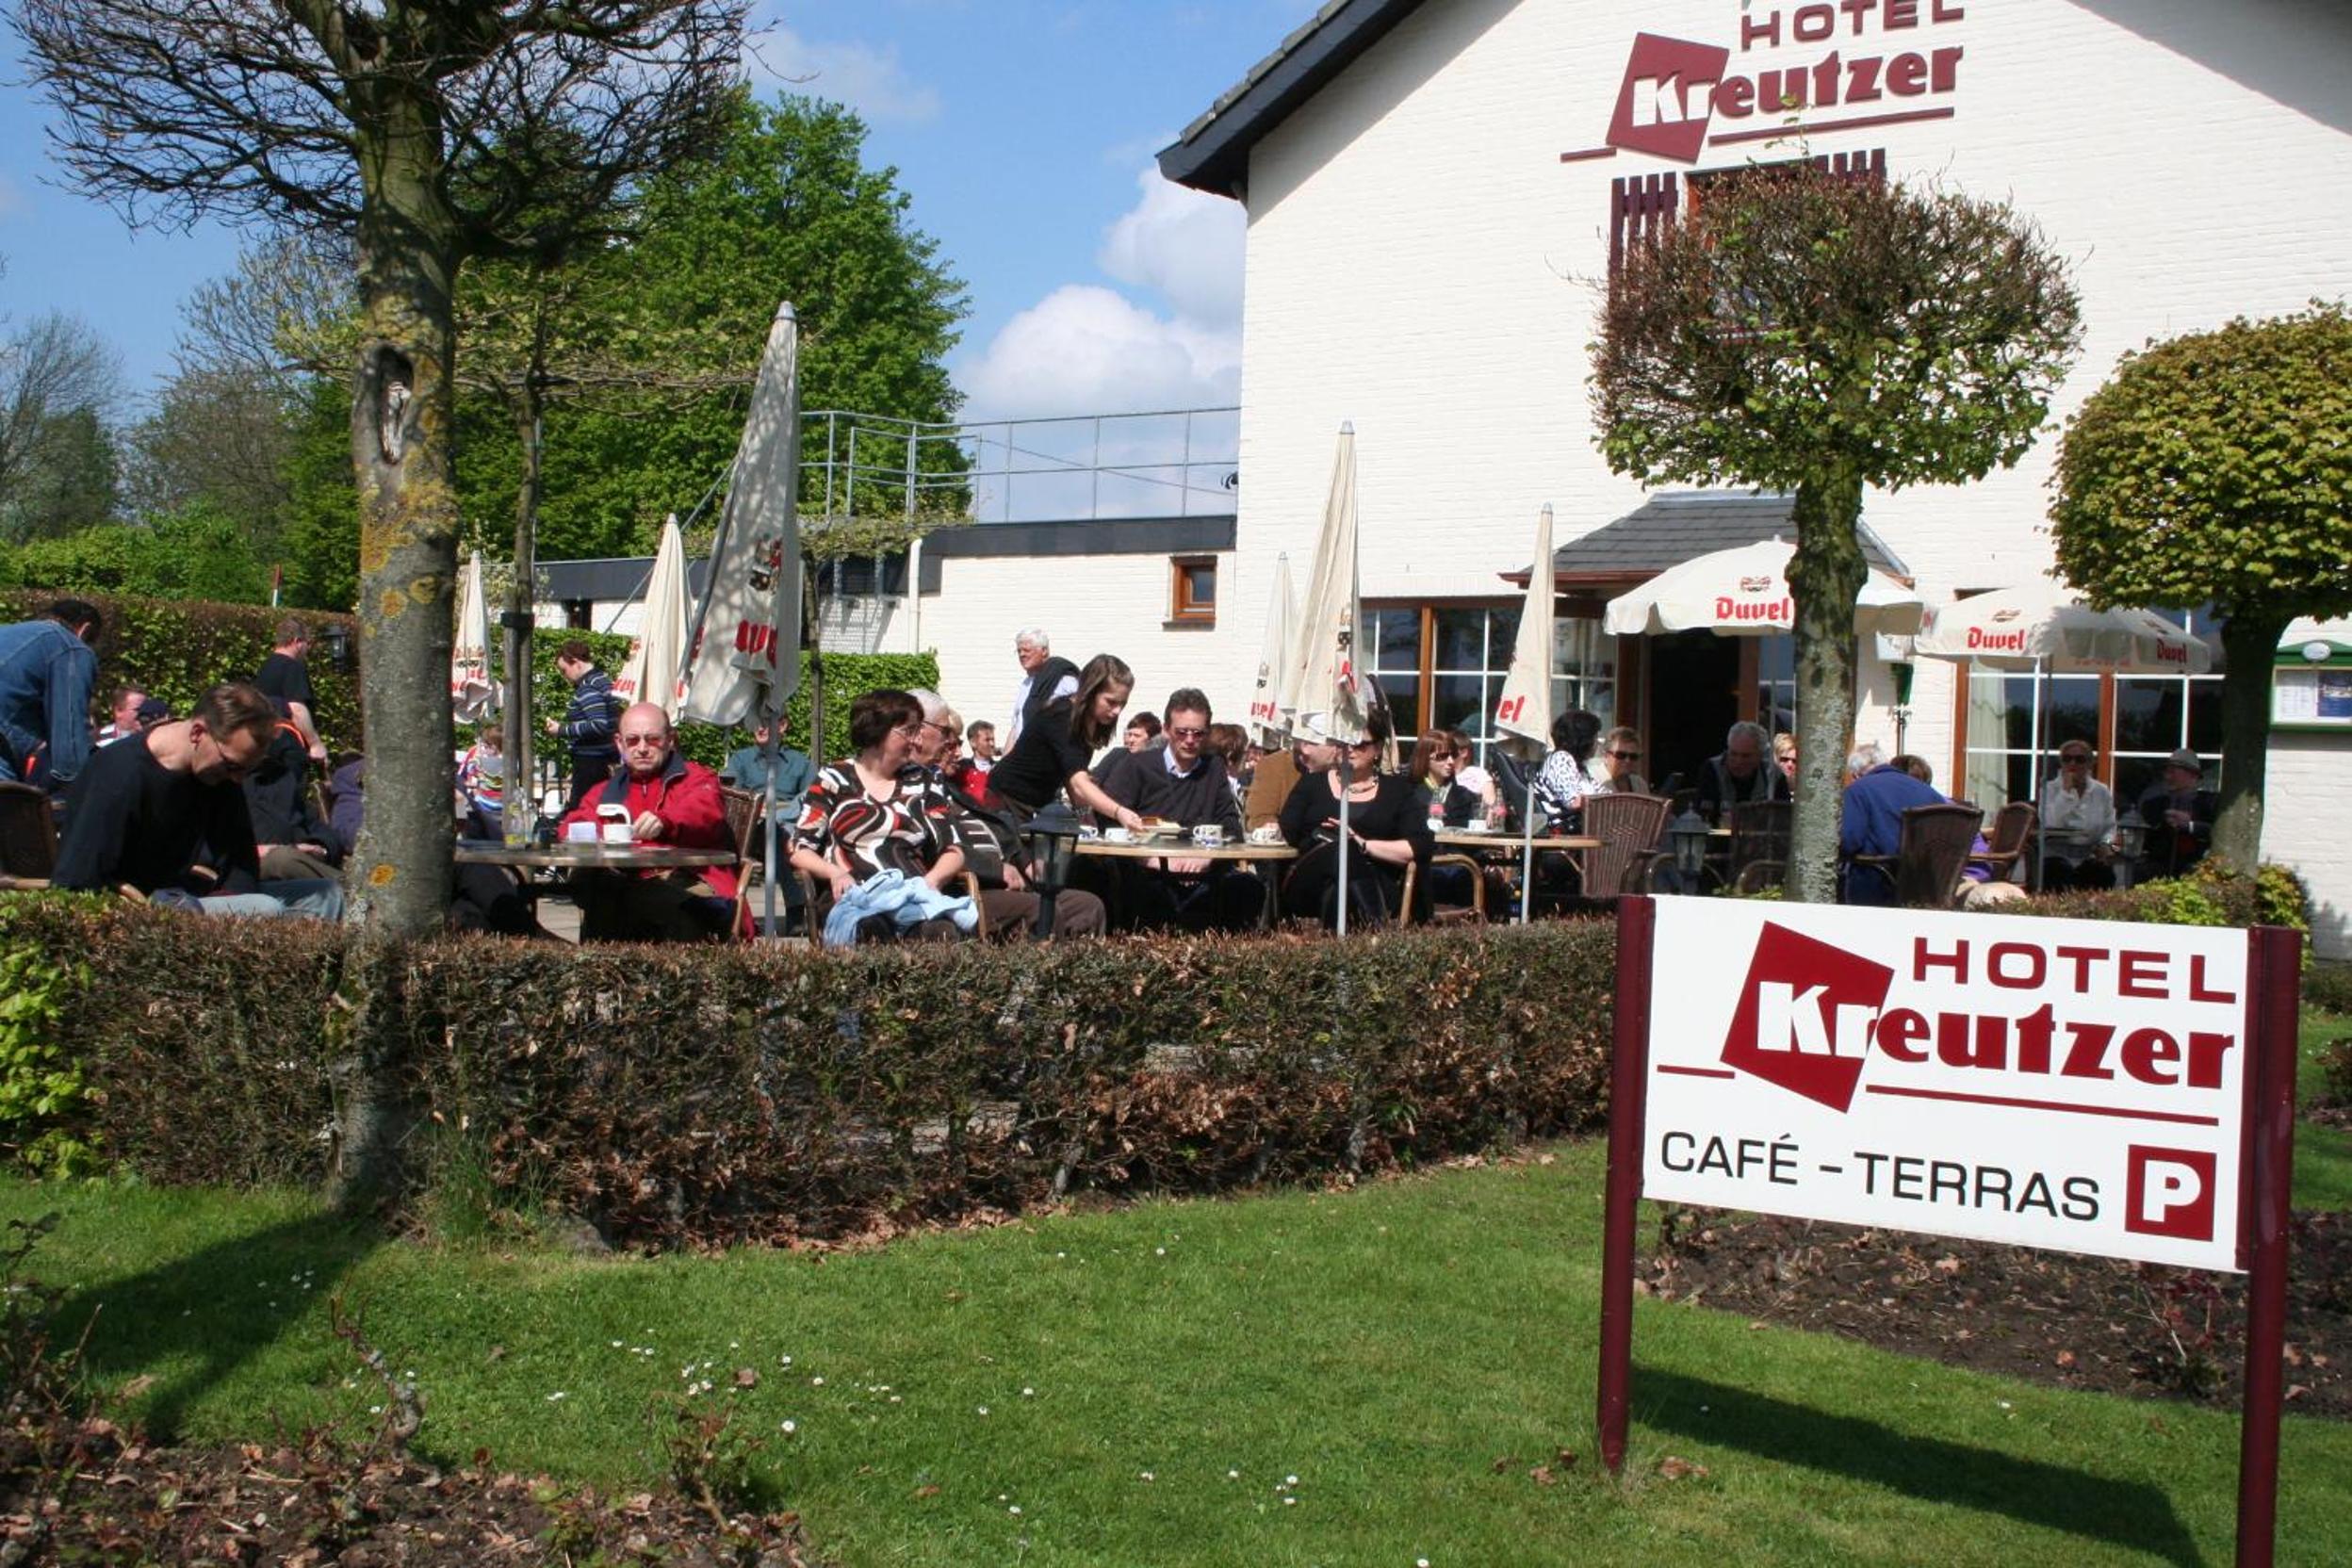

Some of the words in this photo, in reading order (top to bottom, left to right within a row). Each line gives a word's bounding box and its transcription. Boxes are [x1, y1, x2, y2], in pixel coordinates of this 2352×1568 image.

[1740, 0, 1965, 52] HOTEL
[1632, 45, 1965, 127] Kreutzer
[1715, 596, 1789, 621] Duvel
[1967, 626, 2025, 650] Duvel
[2156, 637, 2188, 663] Duvel
[1913, 937, 2237, 1004] HOTEL
[1757, 980, 2236, 1090] Kreutzer
[1660, 1131, 1799, 1186] CAFÉ
[1854, 1152, 2100, 1222] TERRAS
[2142, 1158, 2202, 1224] P
